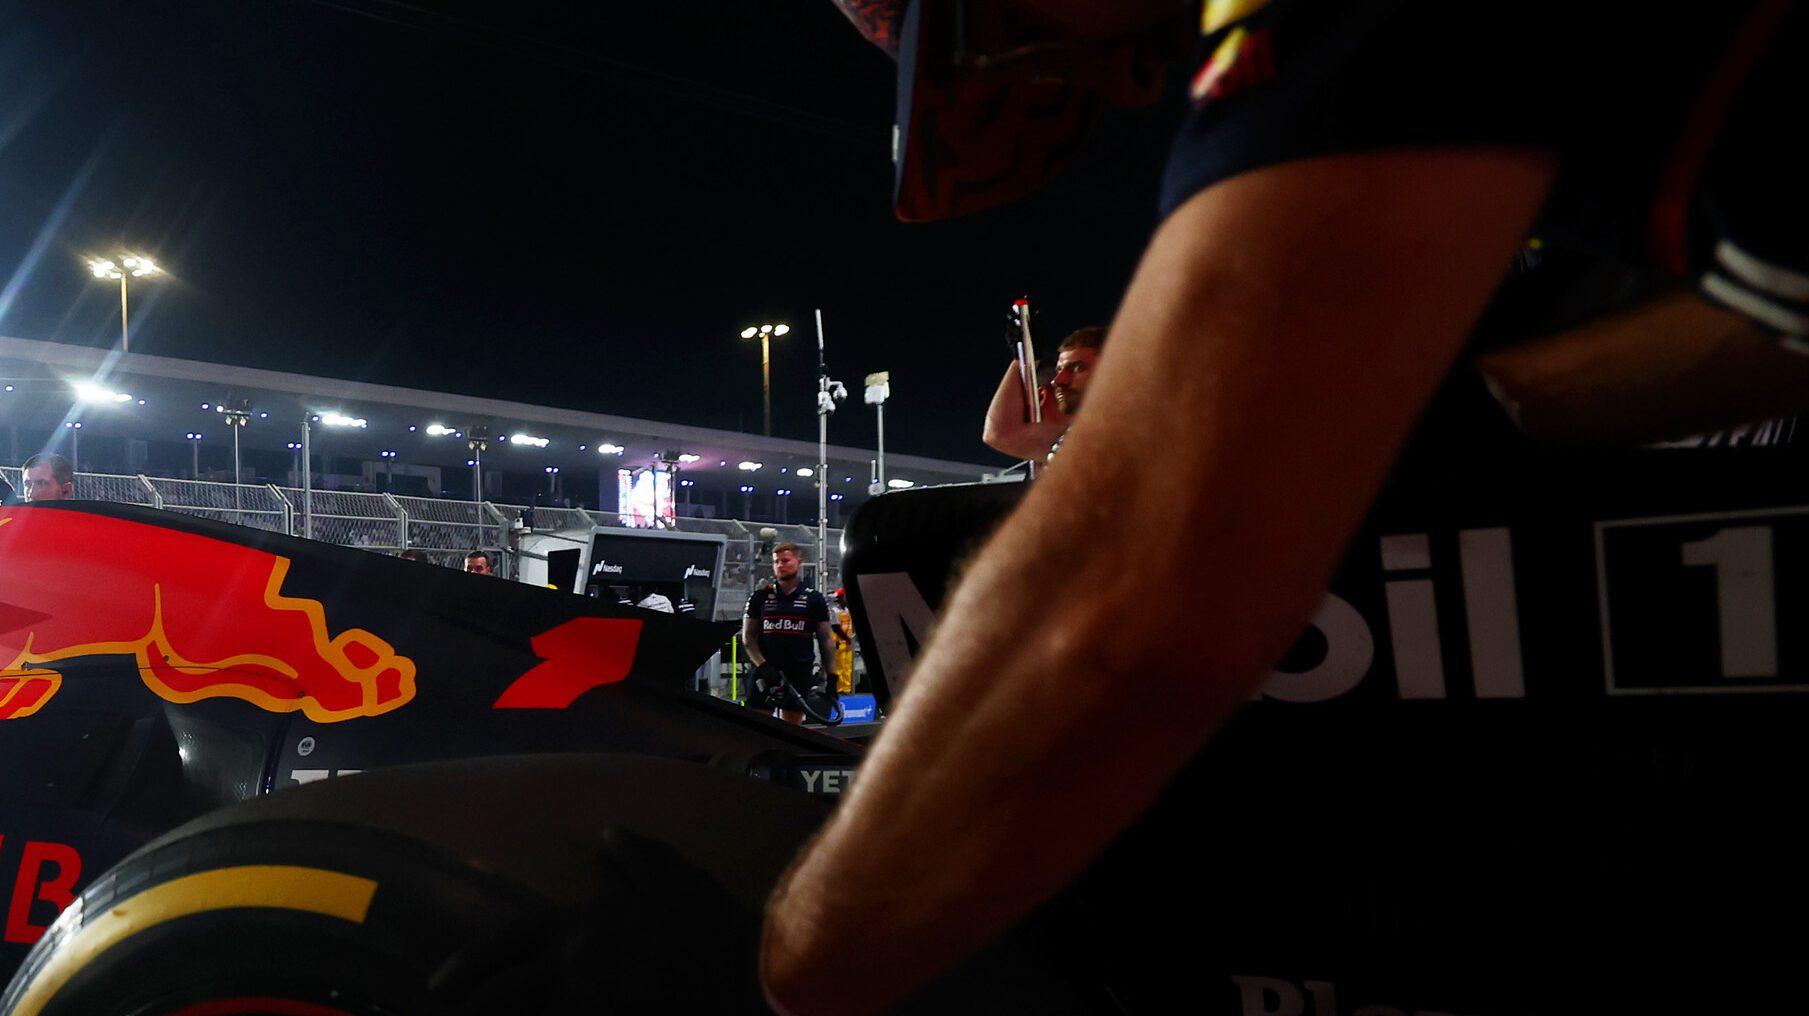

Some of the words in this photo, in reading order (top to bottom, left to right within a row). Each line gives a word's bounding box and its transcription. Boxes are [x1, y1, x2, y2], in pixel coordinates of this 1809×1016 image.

[763, 618, 783, 630] Red
[783, 619, 805, 631] Bull
[1680, 523, 1780, 679] 1
